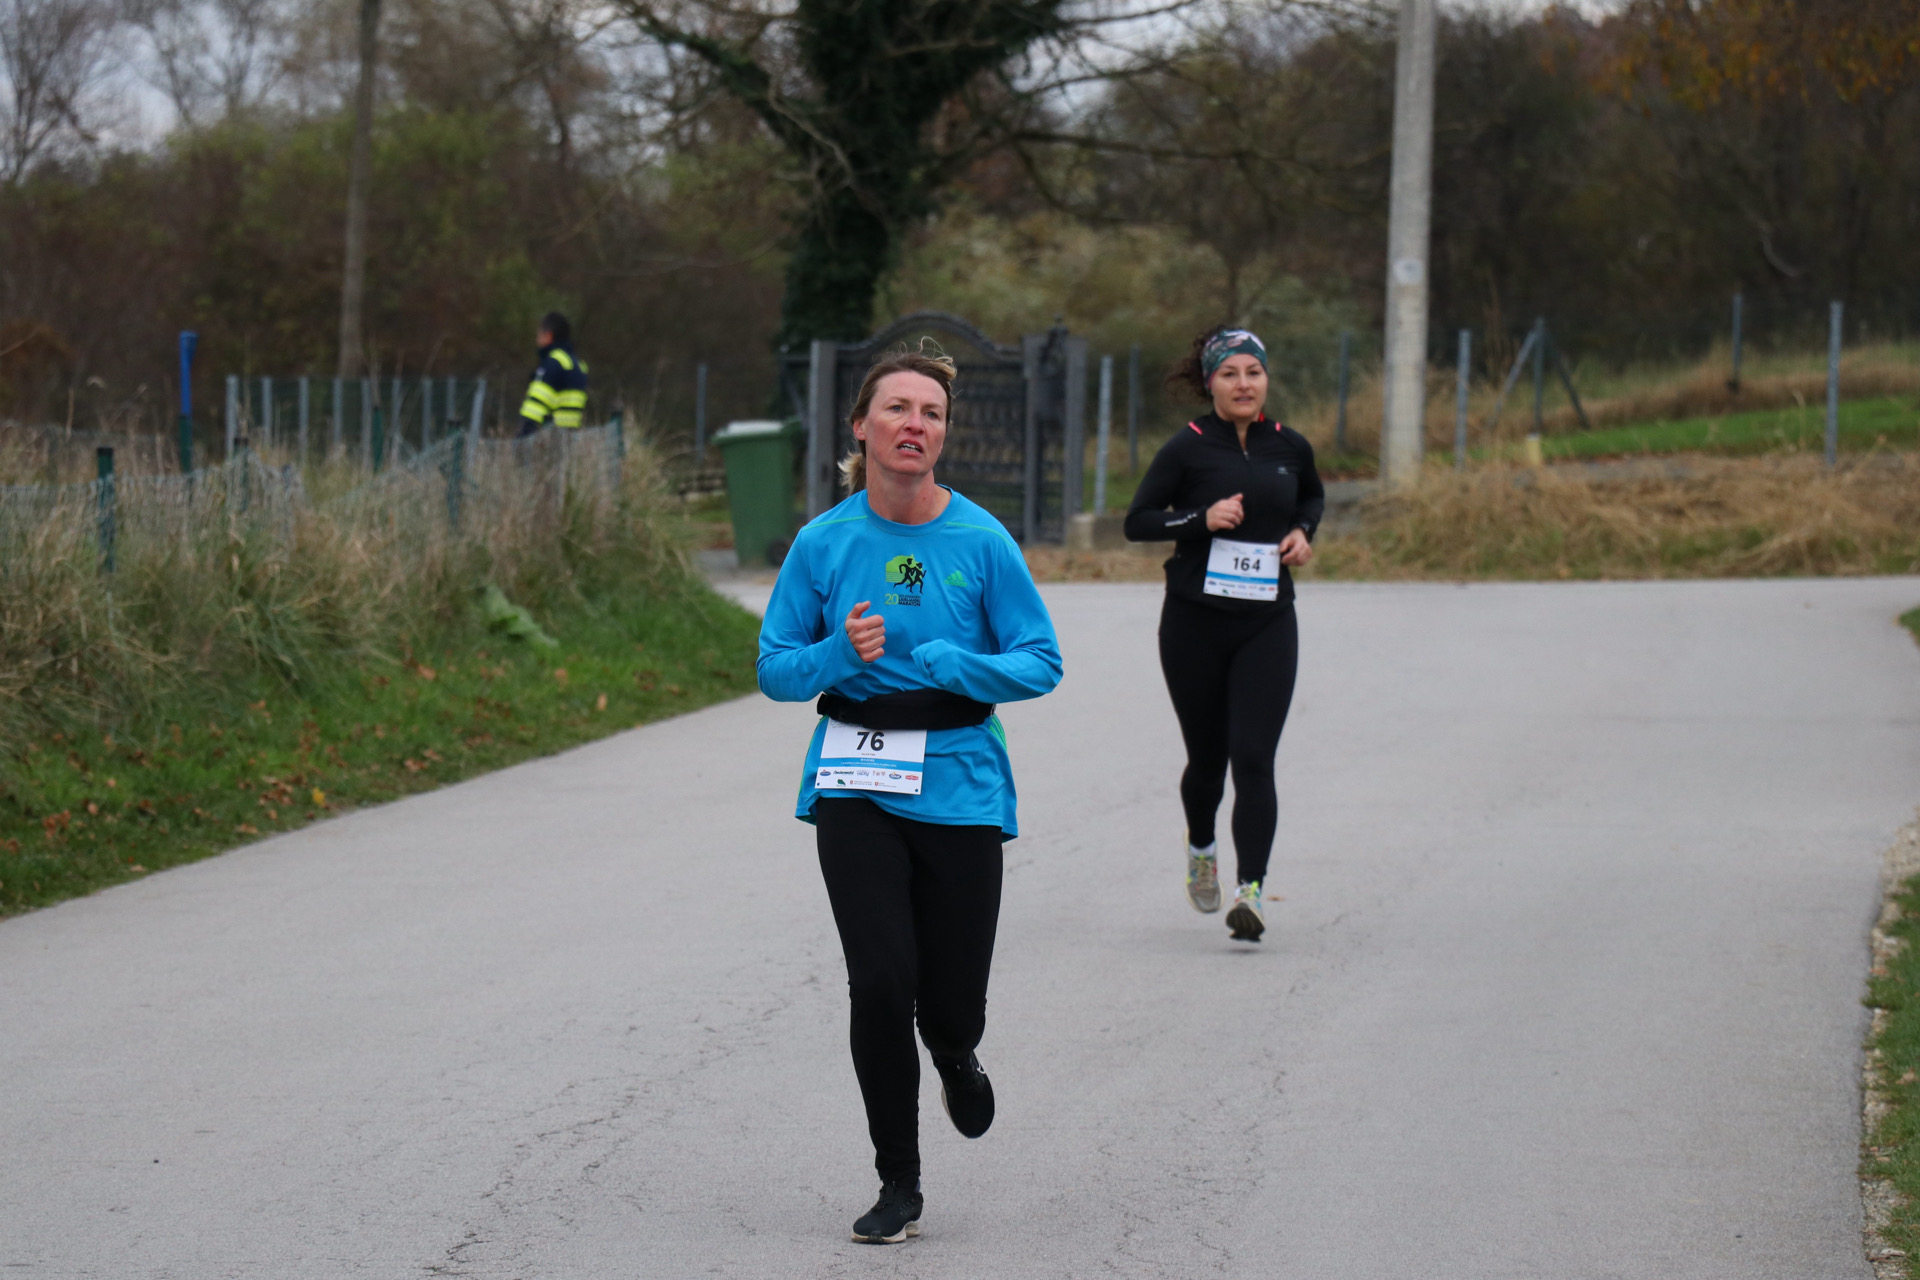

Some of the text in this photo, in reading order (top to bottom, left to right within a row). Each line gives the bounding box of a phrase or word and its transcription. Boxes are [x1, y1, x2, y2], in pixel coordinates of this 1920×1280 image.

[1233, 557, 1260, 572] 164
[884, 593, 899, 605] 20
[857, 731, 885, 751] 76
